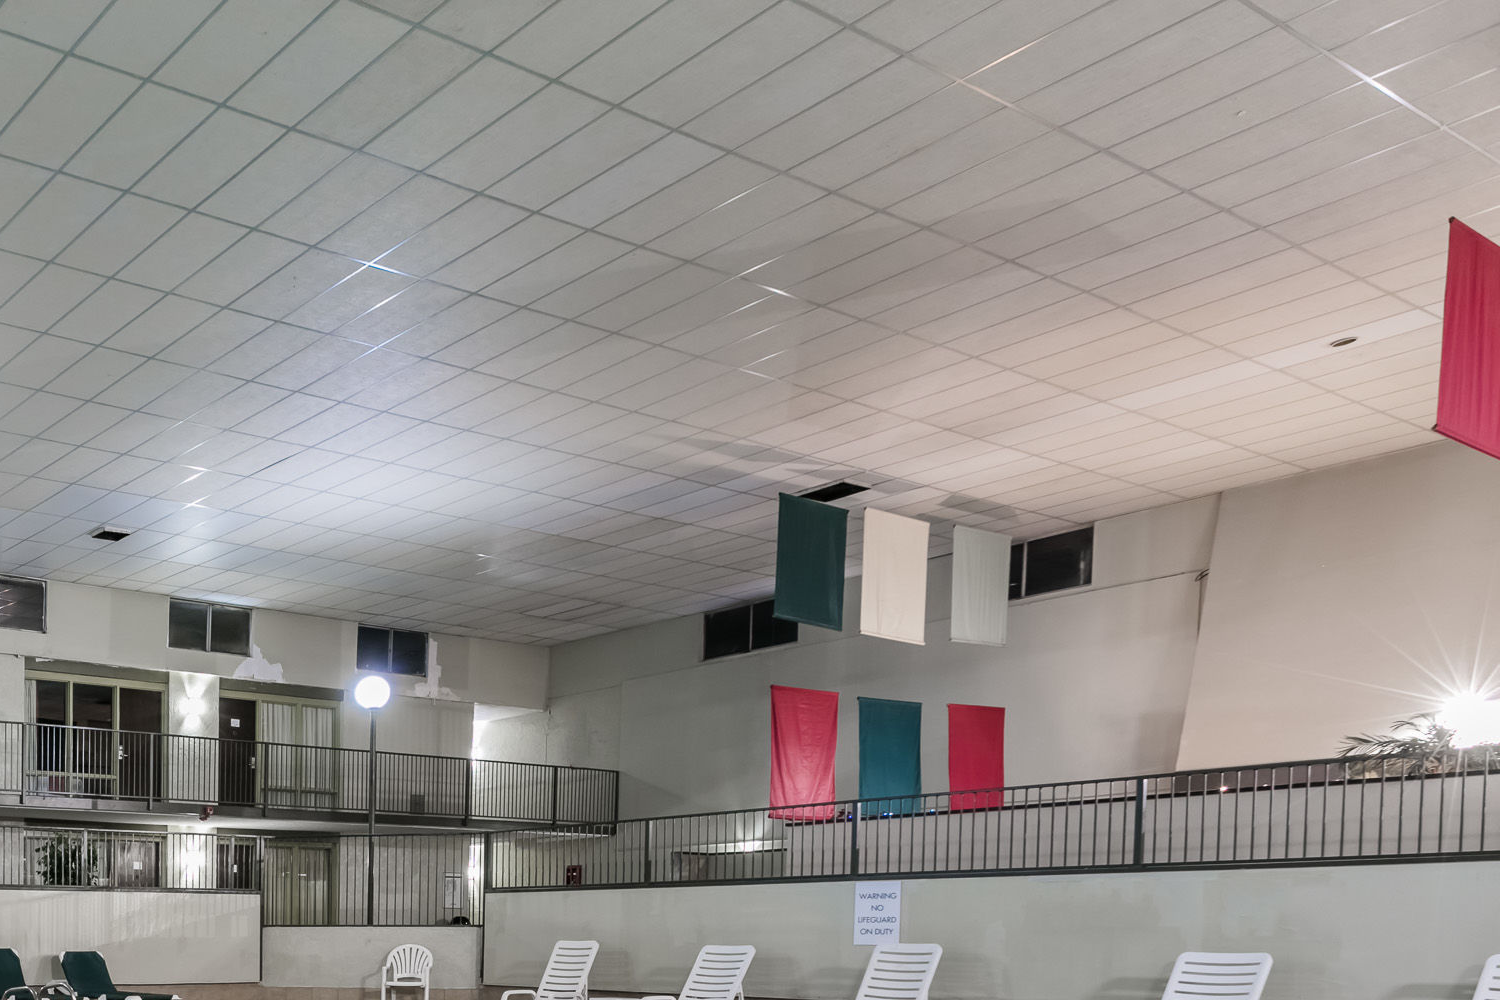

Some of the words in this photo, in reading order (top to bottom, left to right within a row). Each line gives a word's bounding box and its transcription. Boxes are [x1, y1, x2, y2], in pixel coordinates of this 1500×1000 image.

[859, 892, 897, 900] WARNING
[870, 904, 884, 912] NO
[857, 916, 897, 924] LIFEGUARD
